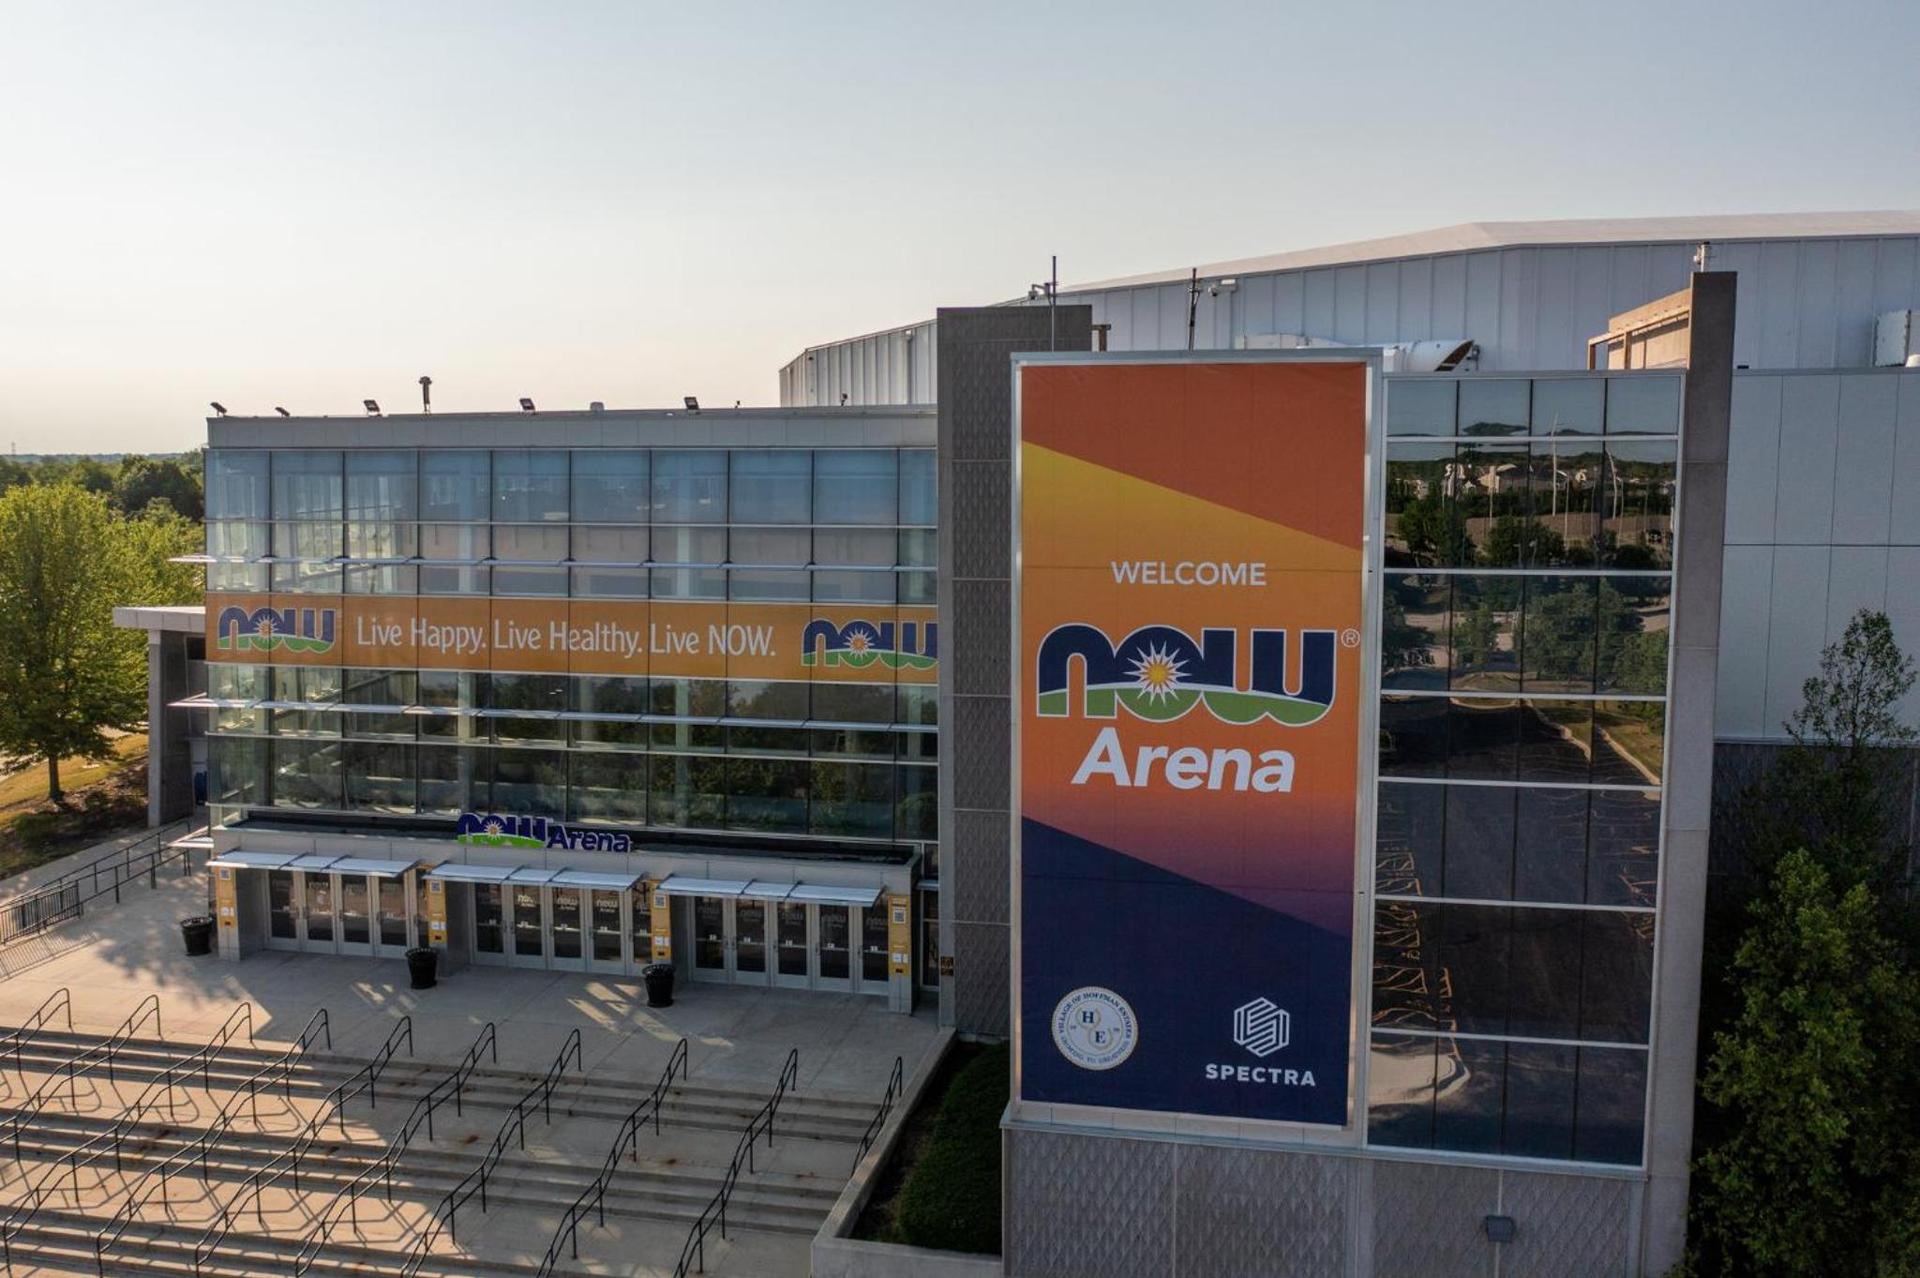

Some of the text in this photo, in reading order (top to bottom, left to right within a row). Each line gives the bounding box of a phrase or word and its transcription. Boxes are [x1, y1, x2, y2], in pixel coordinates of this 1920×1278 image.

[1111, 560, 1267, 587] WELCOME
[357, 616, 776, 659] Live Happy. Live Healthy. Live NOW.
[1070, 726, 1296, 793] Arena
[548, 823, 633, 853] Arena
[1082, 1011, 1094, 1024] H
[1095, 1030, 1106, 1044] E
[1205, 1063, 1317, 1087] SPECTRA
